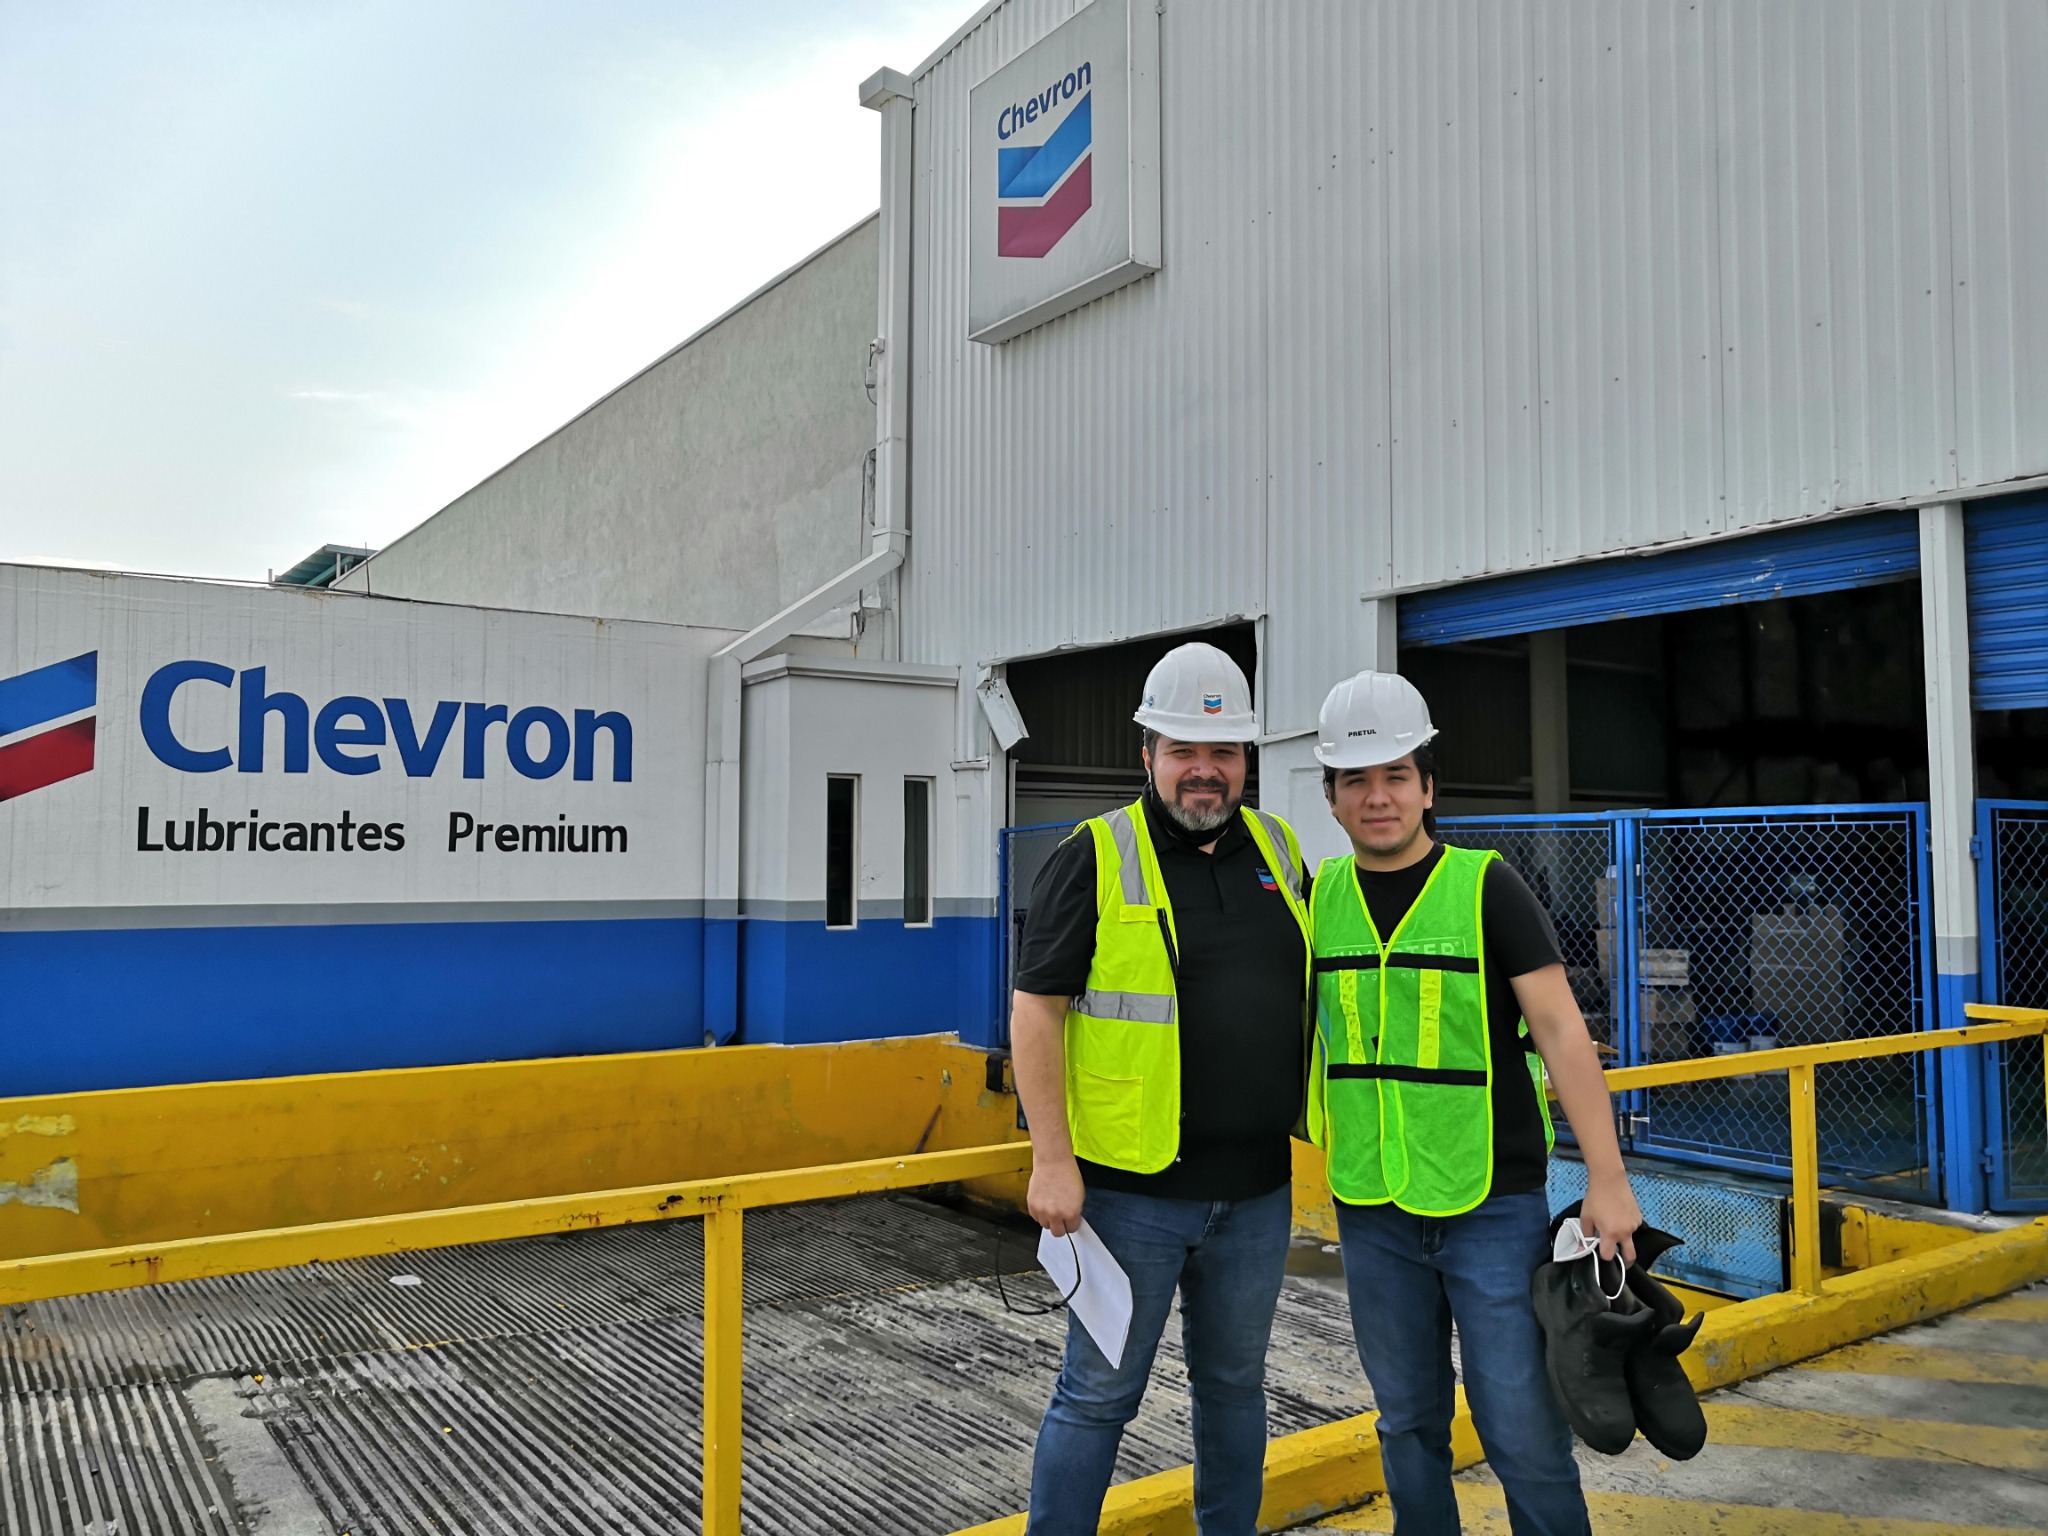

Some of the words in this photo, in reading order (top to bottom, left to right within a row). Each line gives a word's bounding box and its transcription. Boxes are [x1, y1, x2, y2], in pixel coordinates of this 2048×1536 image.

[997, 61, 1092, 140] Chevron
[140, 660, 633, 782] Chevron
[1348, 729, 1377, 737] PRETUL
[137, 806, 405, 852] Lubricantes
[448, 811, 628, 852] Premium
